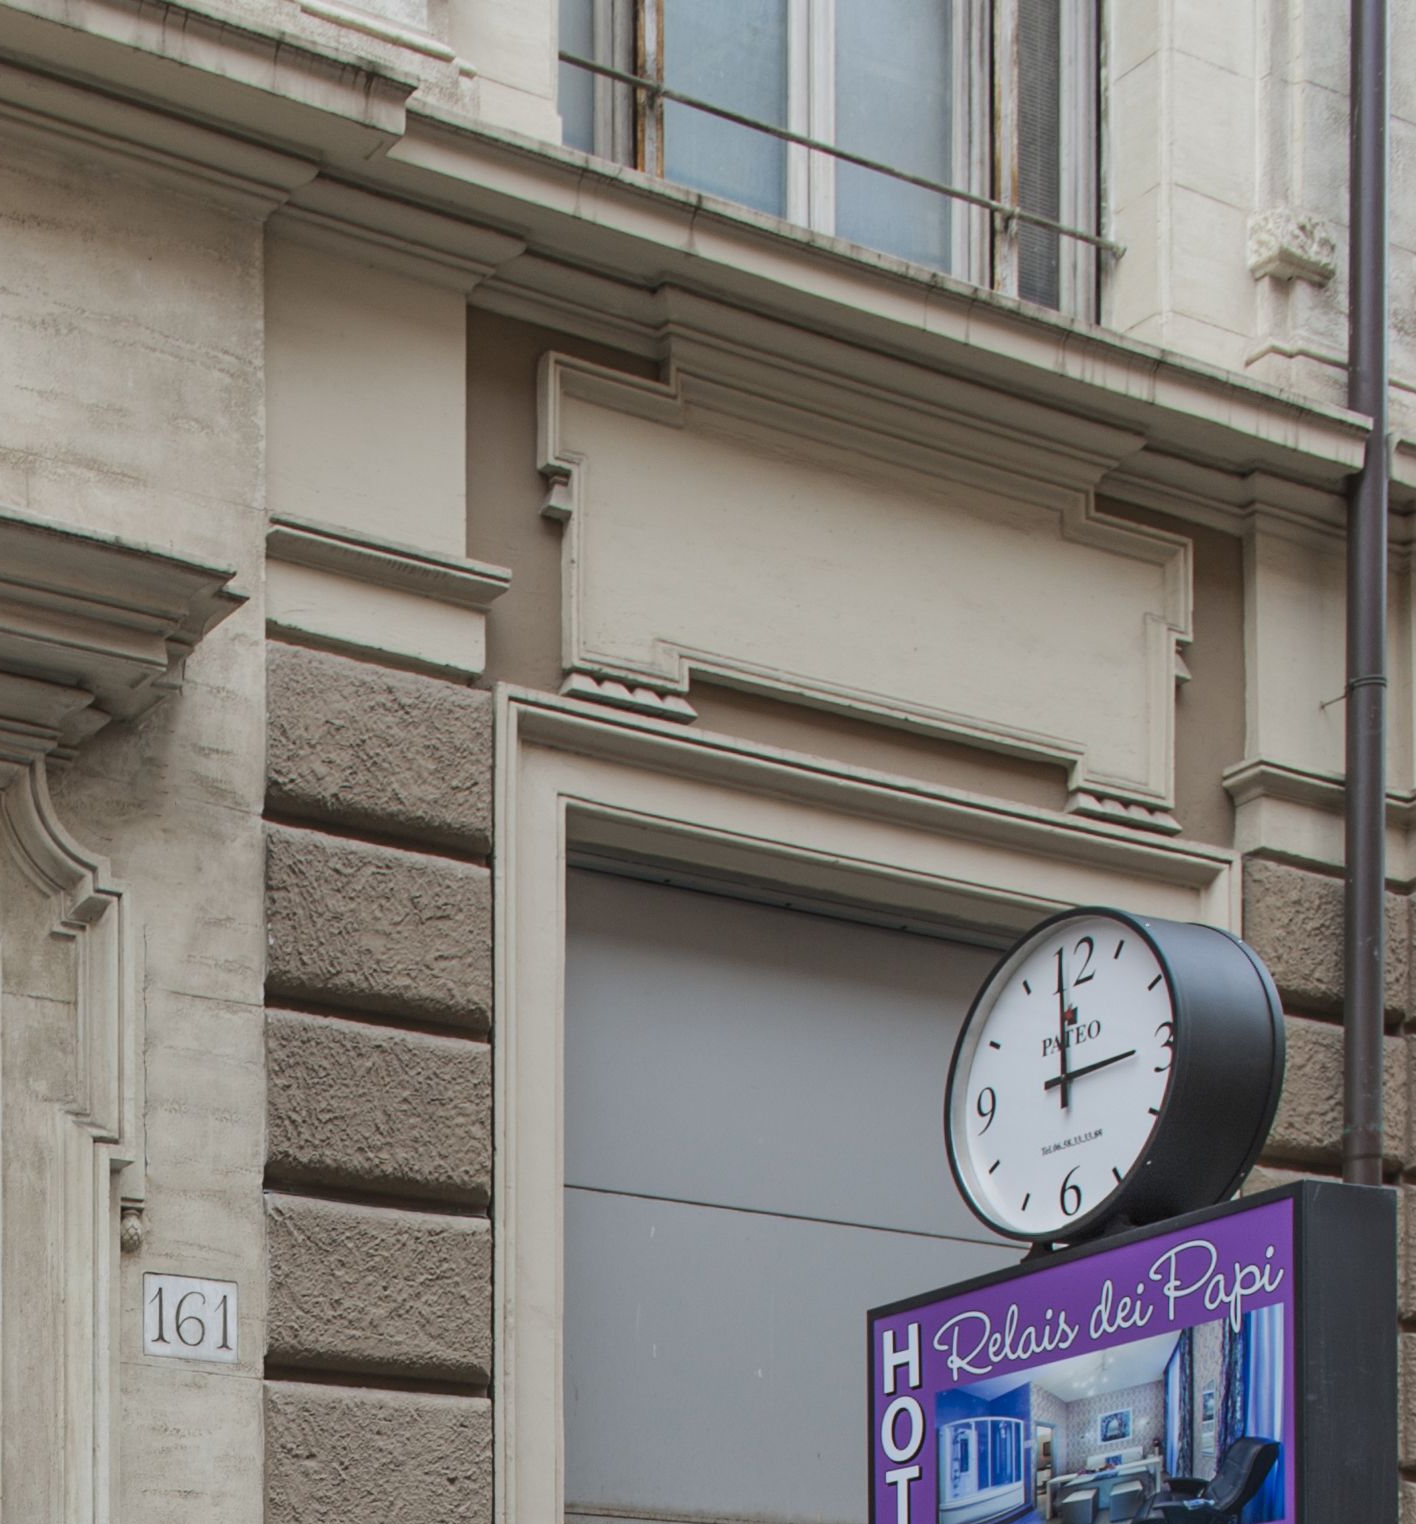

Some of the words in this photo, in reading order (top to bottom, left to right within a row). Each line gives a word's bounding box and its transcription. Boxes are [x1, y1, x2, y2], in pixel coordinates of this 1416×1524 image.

[1052, 936, 1097, 996] 12
[1041, 1019, 1101, 1057] PATEO
[1154, 1022, 1174, 1074] 3
[976, 1087, 997, 1137] 9
[1060, 1166, 1082, 1216] 6
[148, 1287, 233, 1351] 161
[932, 1303, 1079, 1381] Relais
[1089, 1279, 1153, 1341] dei
[1148, 1239, 1284, 1333] Papi
